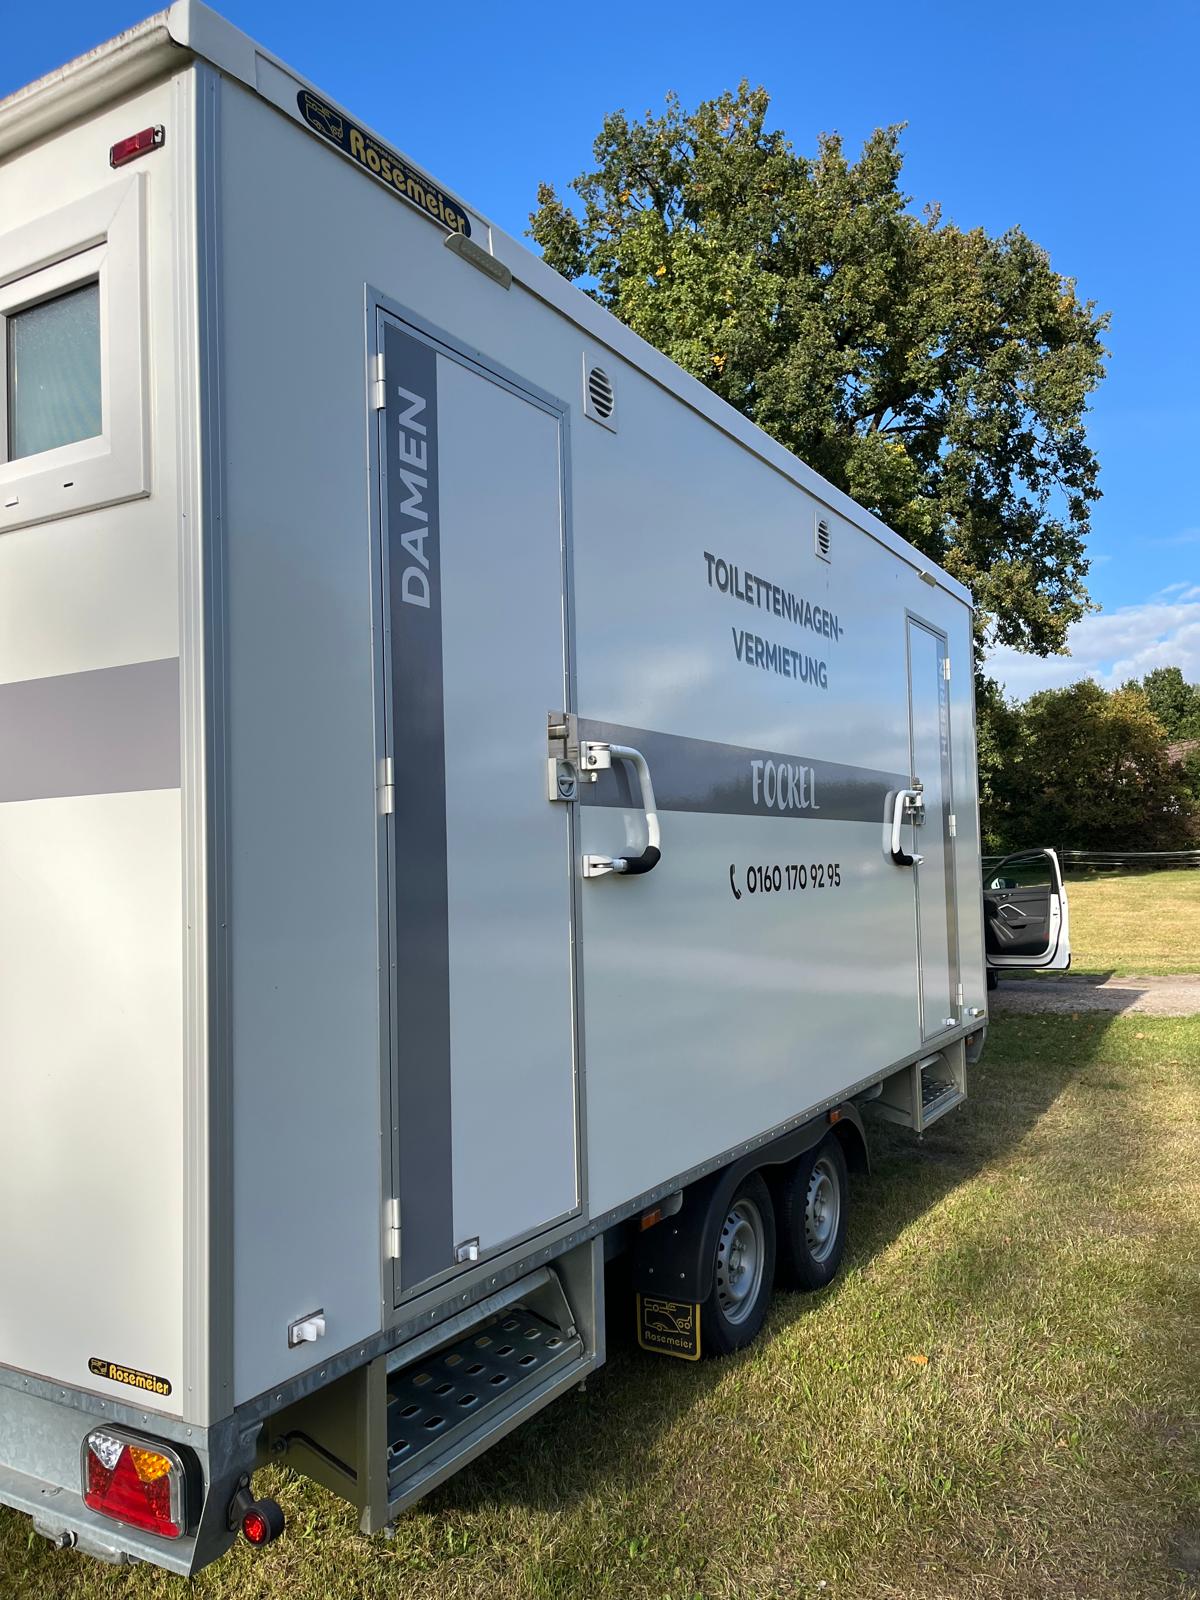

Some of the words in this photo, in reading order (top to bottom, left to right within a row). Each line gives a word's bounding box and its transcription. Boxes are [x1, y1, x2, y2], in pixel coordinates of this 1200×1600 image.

[350, 128, 465, 233] Rosemeier
[398, 386, 431, 609] DAMEN
[703, 550, 844, 642] TOILETTENWAGEN-
[731, 626, 829, 690] VERMIETUNG
[750, 759, 820, 810] FOCKEL
[746, 864, 782, 894] 0160
[785, 864, 807, 890] 170
[810, 863, 825, 889] 92
[827, 863, 841, 887] 95
[645, 1330, 693, 1349] Rosemeier
[109, 1364, 169, 1395] Rosemeier
